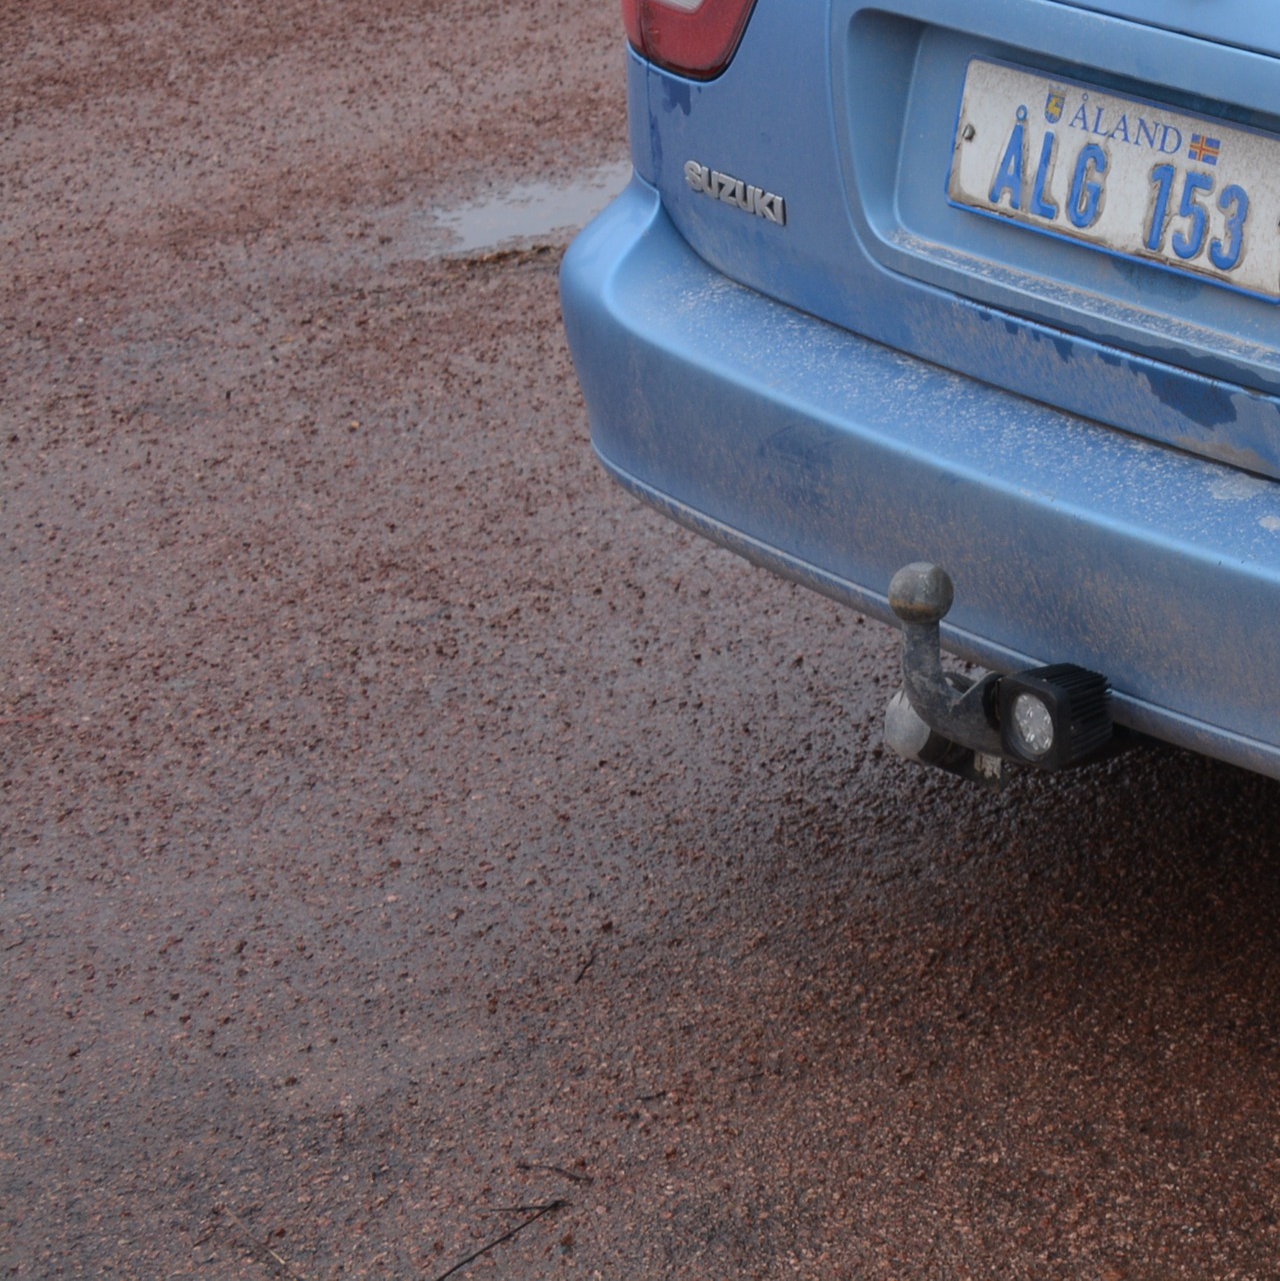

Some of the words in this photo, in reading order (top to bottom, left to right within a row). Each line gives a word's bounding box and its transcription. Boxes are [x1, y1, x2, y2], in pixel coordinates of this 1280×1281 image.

[1069, 92, 1182, 155] ÅLAND
[684, 159, 786, 226] SUZUKI
[989, 104, 1108, 229] ÅLG
[1146, 164, 1250, 271] 153
